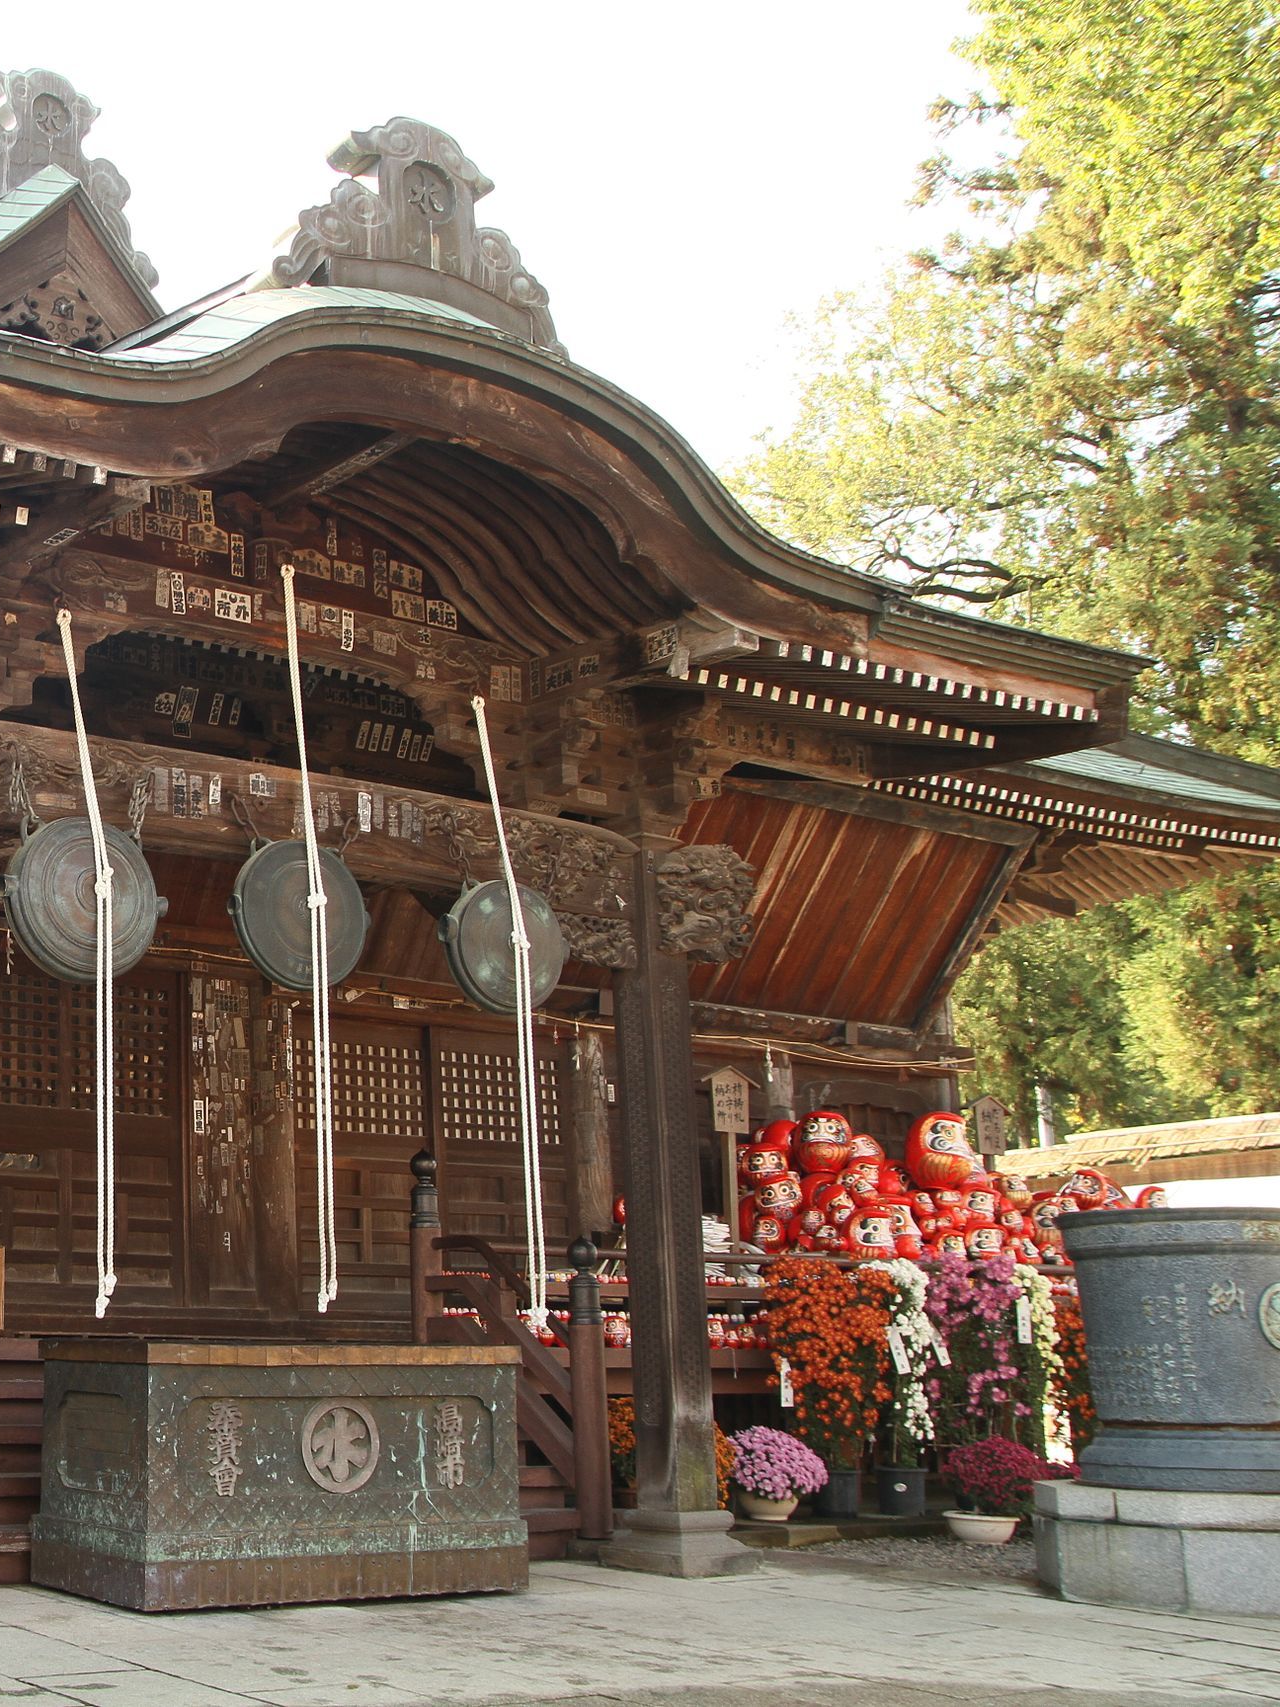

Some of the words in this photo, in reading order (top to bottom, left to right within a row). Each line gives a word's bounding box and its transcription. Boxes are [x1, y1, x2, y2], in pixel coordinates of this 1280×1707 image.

[217, 600, 250, 620] 外所
[433, 1399, 465, 1490] 高崎市
